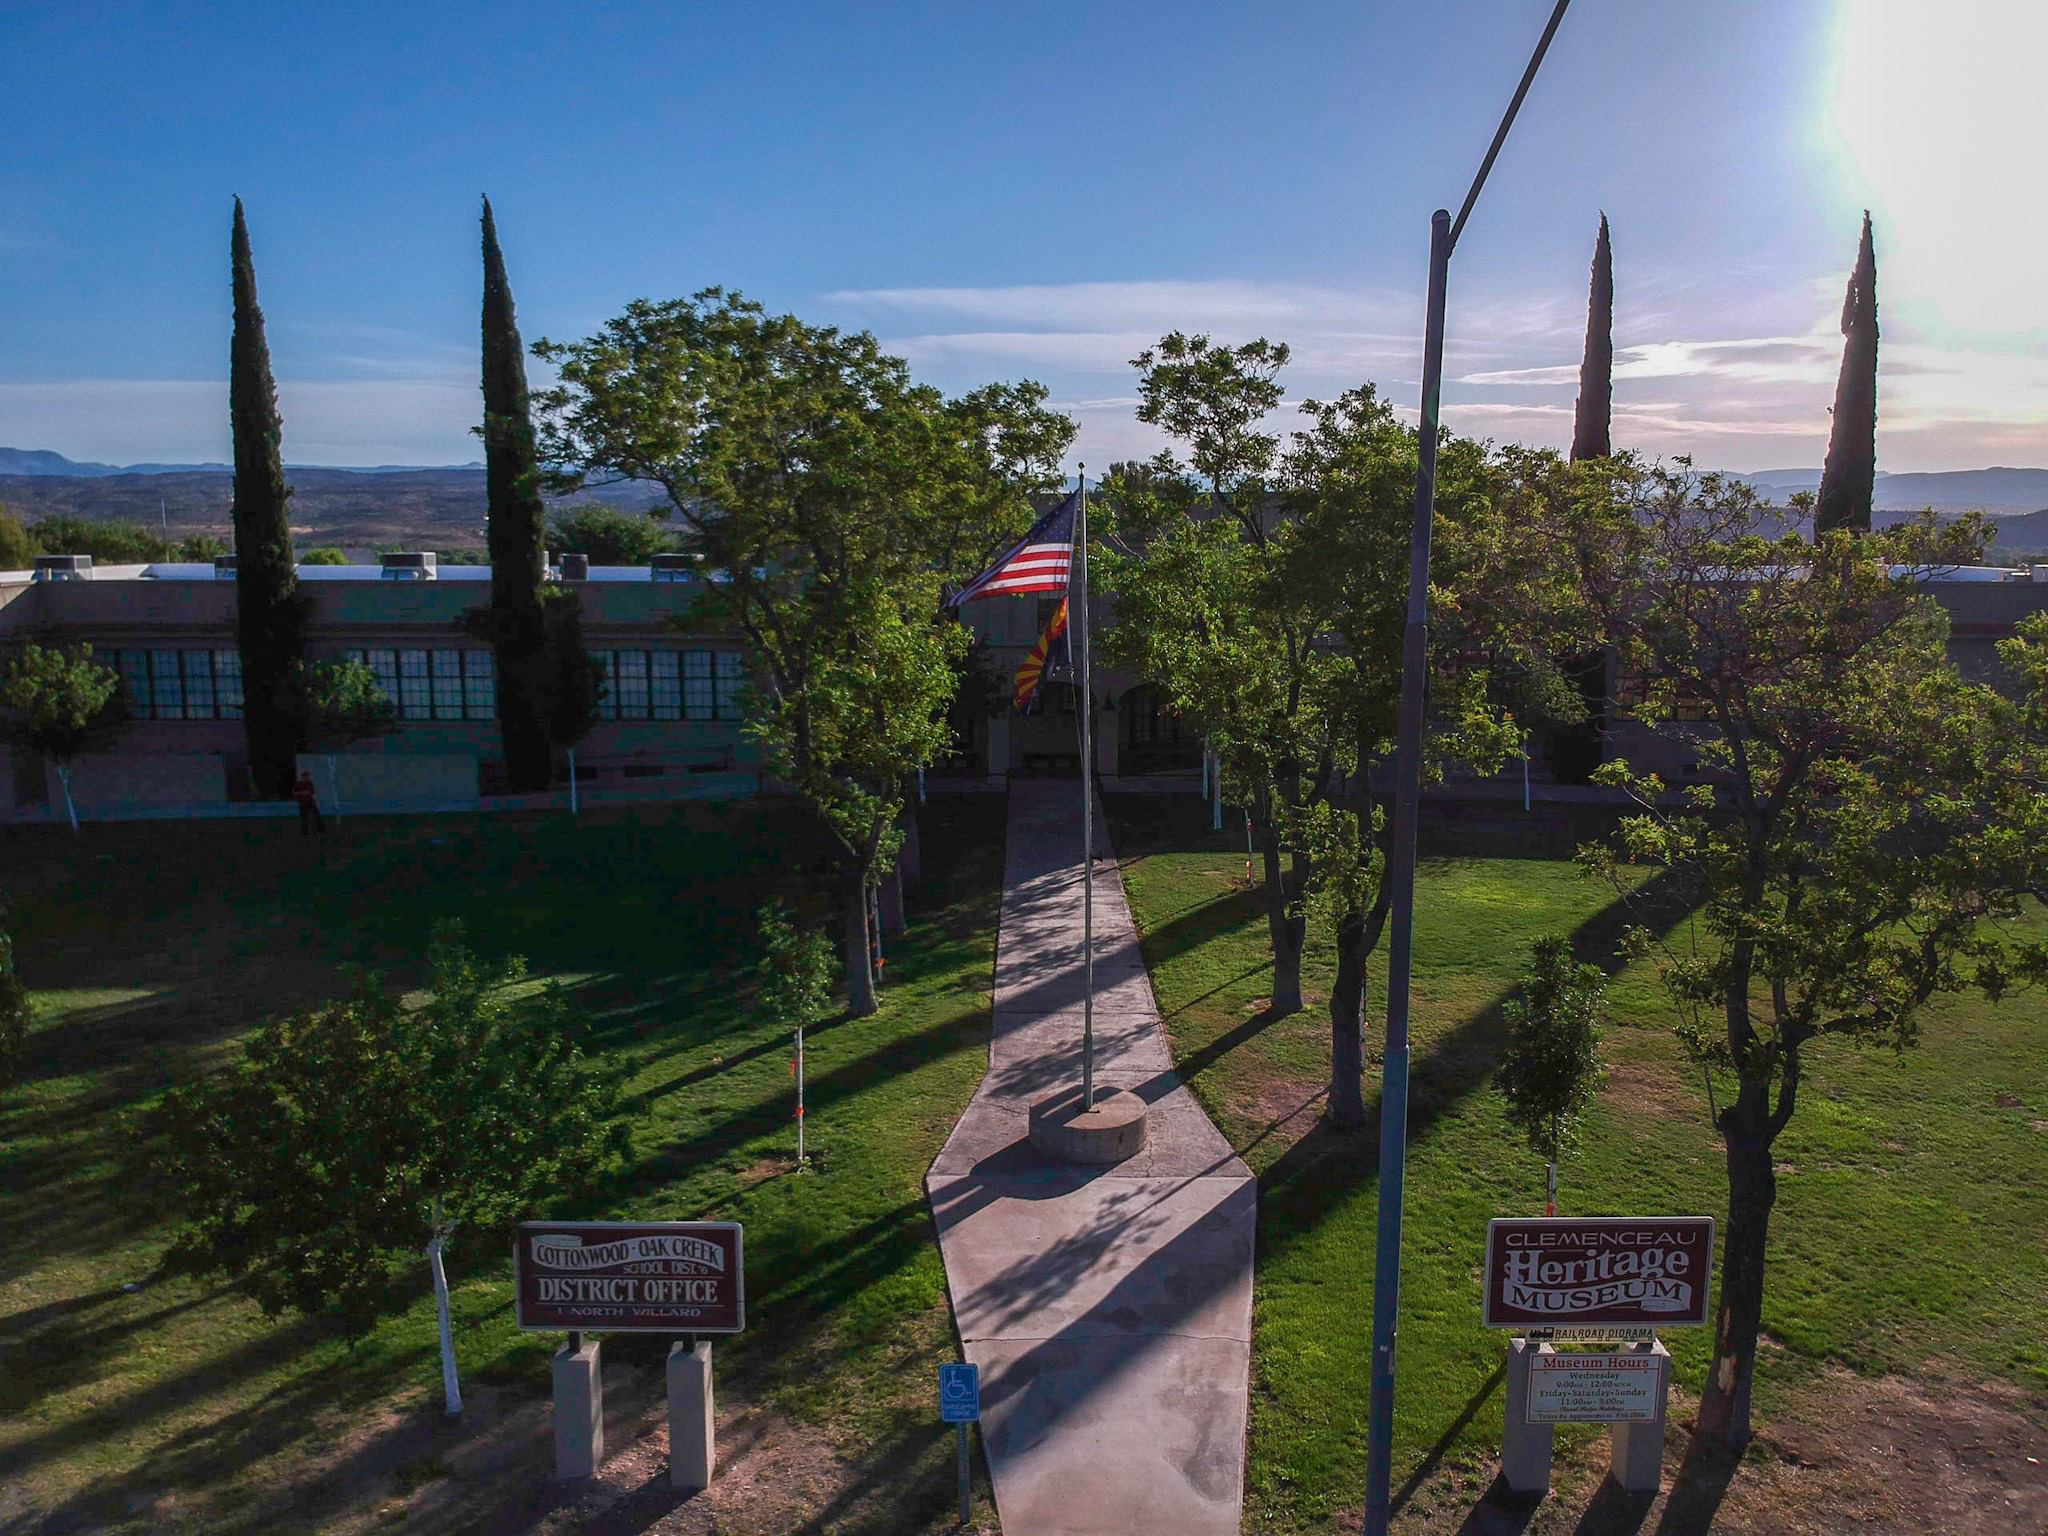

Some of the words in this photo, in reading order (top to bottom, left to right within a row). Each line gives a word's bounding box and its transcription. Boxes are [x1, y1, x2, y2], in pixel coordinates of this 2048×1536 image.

[1505, 1232, 1696, 1247] CLEMENCEAU
[537, 1244, 630, 1265] COTTONWOOD
[639, 1239, 674, 1256] OAK
[672, 1238, 718, 1264] CREEK
[623, 1262, 668, 1275] SCHOOL
[1504, 1248, 1689, 1286] Heritage
[538, 1278, 640, 1302] DISTRICT
[644, 1279, 718, 1302] OFFICE
[1511, 1280, 1683, 1310] MUSEUM
[571, 1307, 624, 1317] NORTH
[632, 1307, 701, 1317] WILLARD
[1555, 1328, 1605, 1338] RAILROAD
[1608, 1328, 1653, 1338] DIORAMA
[1543, 1357, 1603, 1369] Museum
[1608, 1357, 1649, 1368] Hours
[1570, 1371, 1620, 1380] Wednesday
